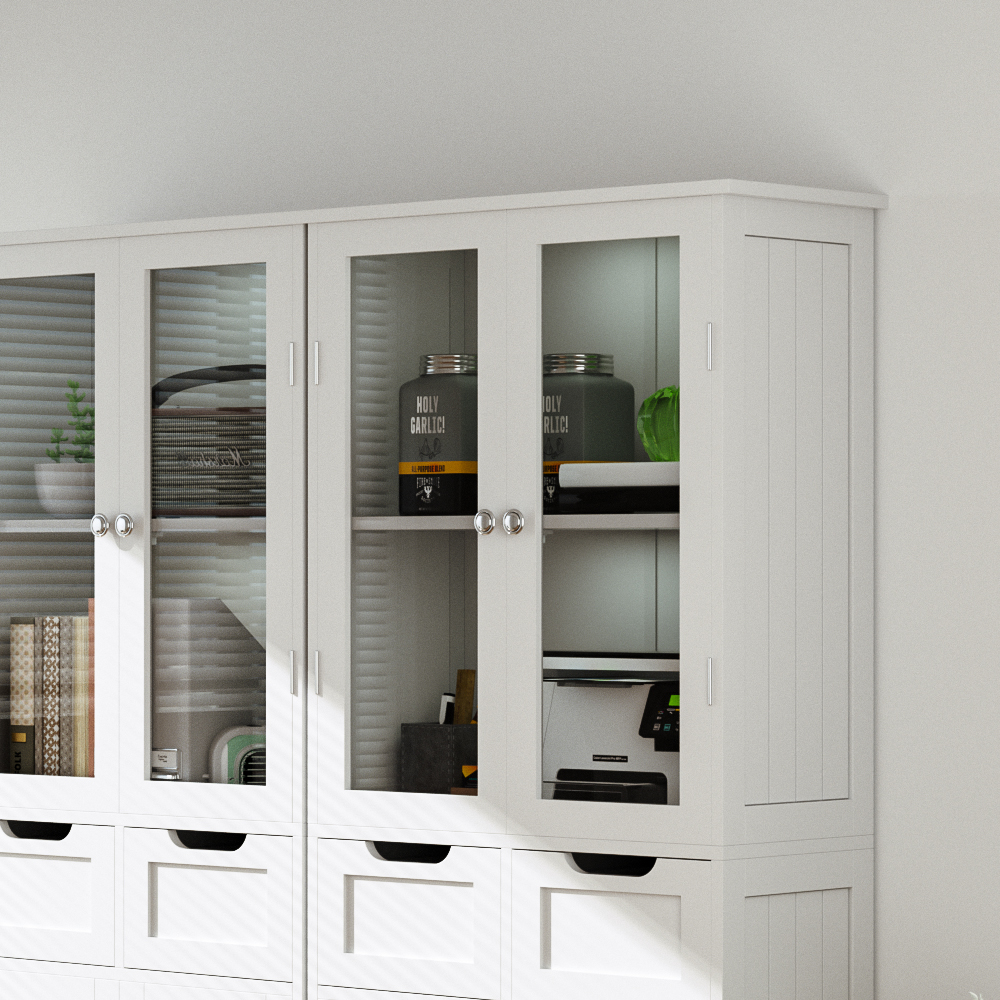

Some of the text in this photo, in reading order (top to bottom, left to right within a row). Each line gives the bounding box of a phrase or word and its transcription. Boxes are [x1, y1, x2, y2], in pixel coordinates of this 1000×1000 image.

[416, 395, 439, 414] HOLY
[410, 415, 446, 435] GARLIC!
[543, 415, 569, 434] RLIC!
